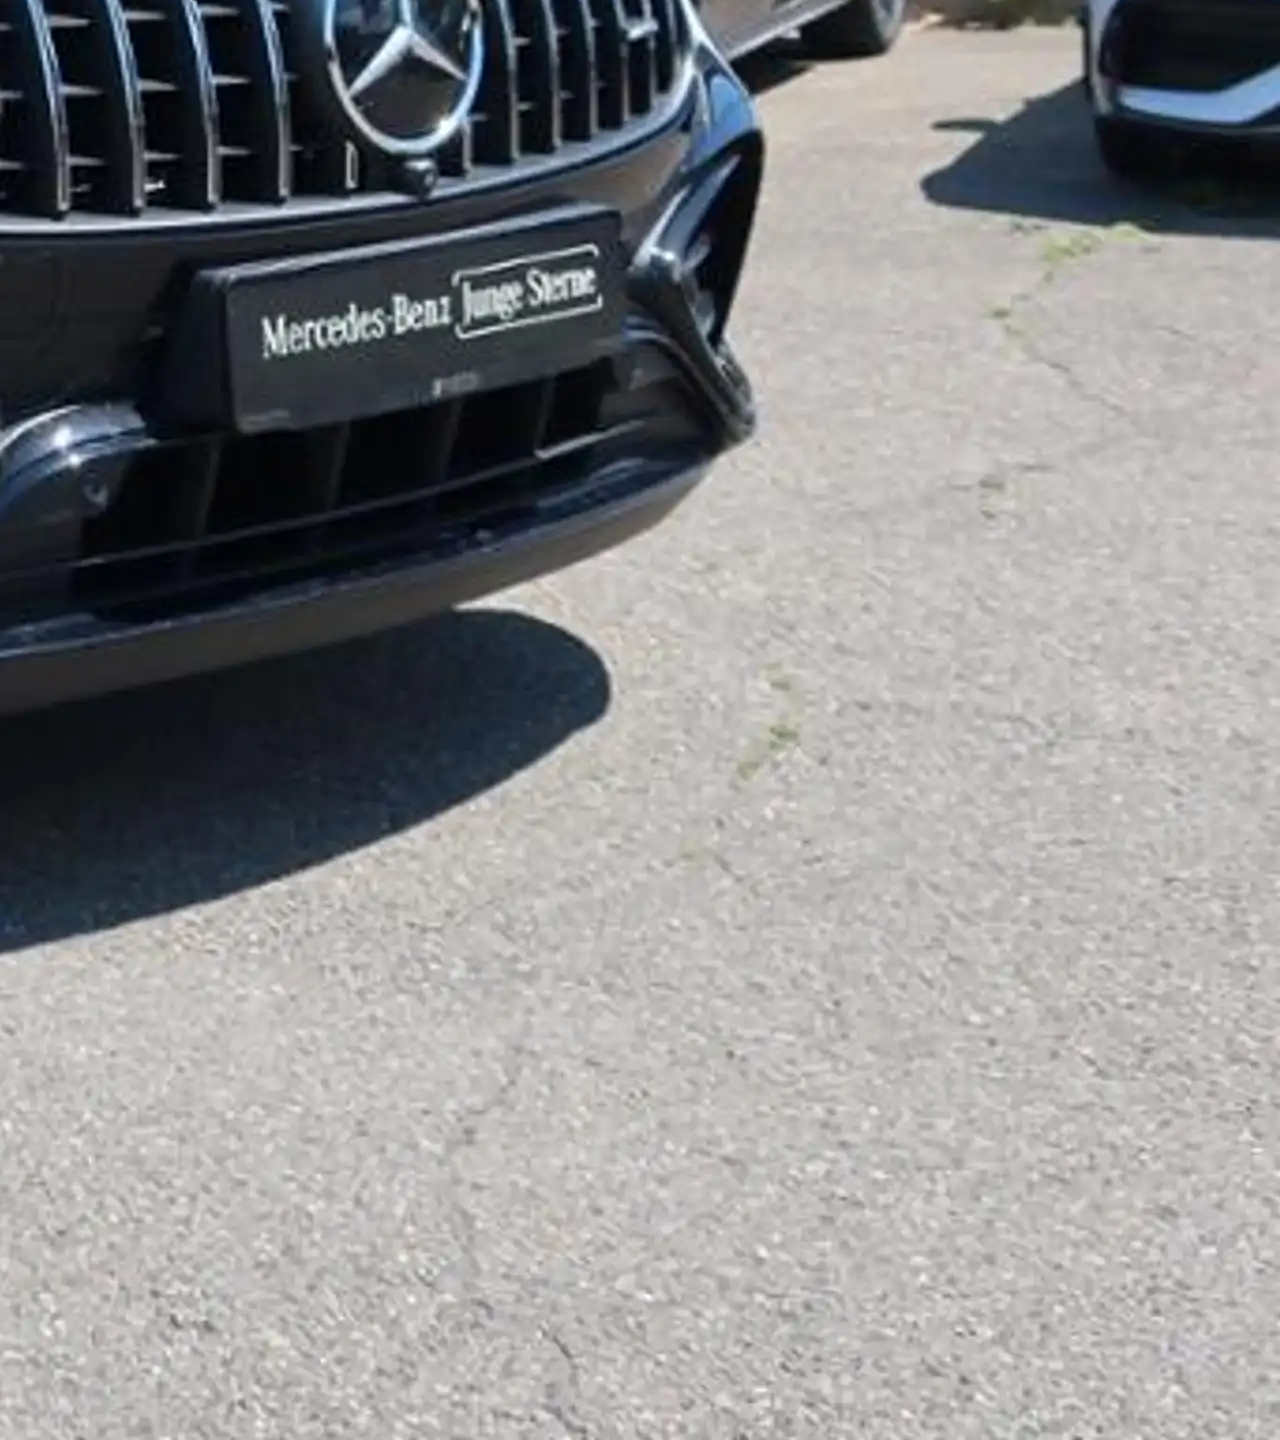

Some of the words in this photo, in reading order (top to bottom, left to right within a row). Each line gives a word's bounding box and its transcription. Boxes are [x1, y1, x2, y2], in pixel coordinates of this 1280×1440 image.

[260, 292, 453, 359] Mercedes-Benz
[461, 278, 525, 327] Junge
[525, 266, 597, 307] Sterne
